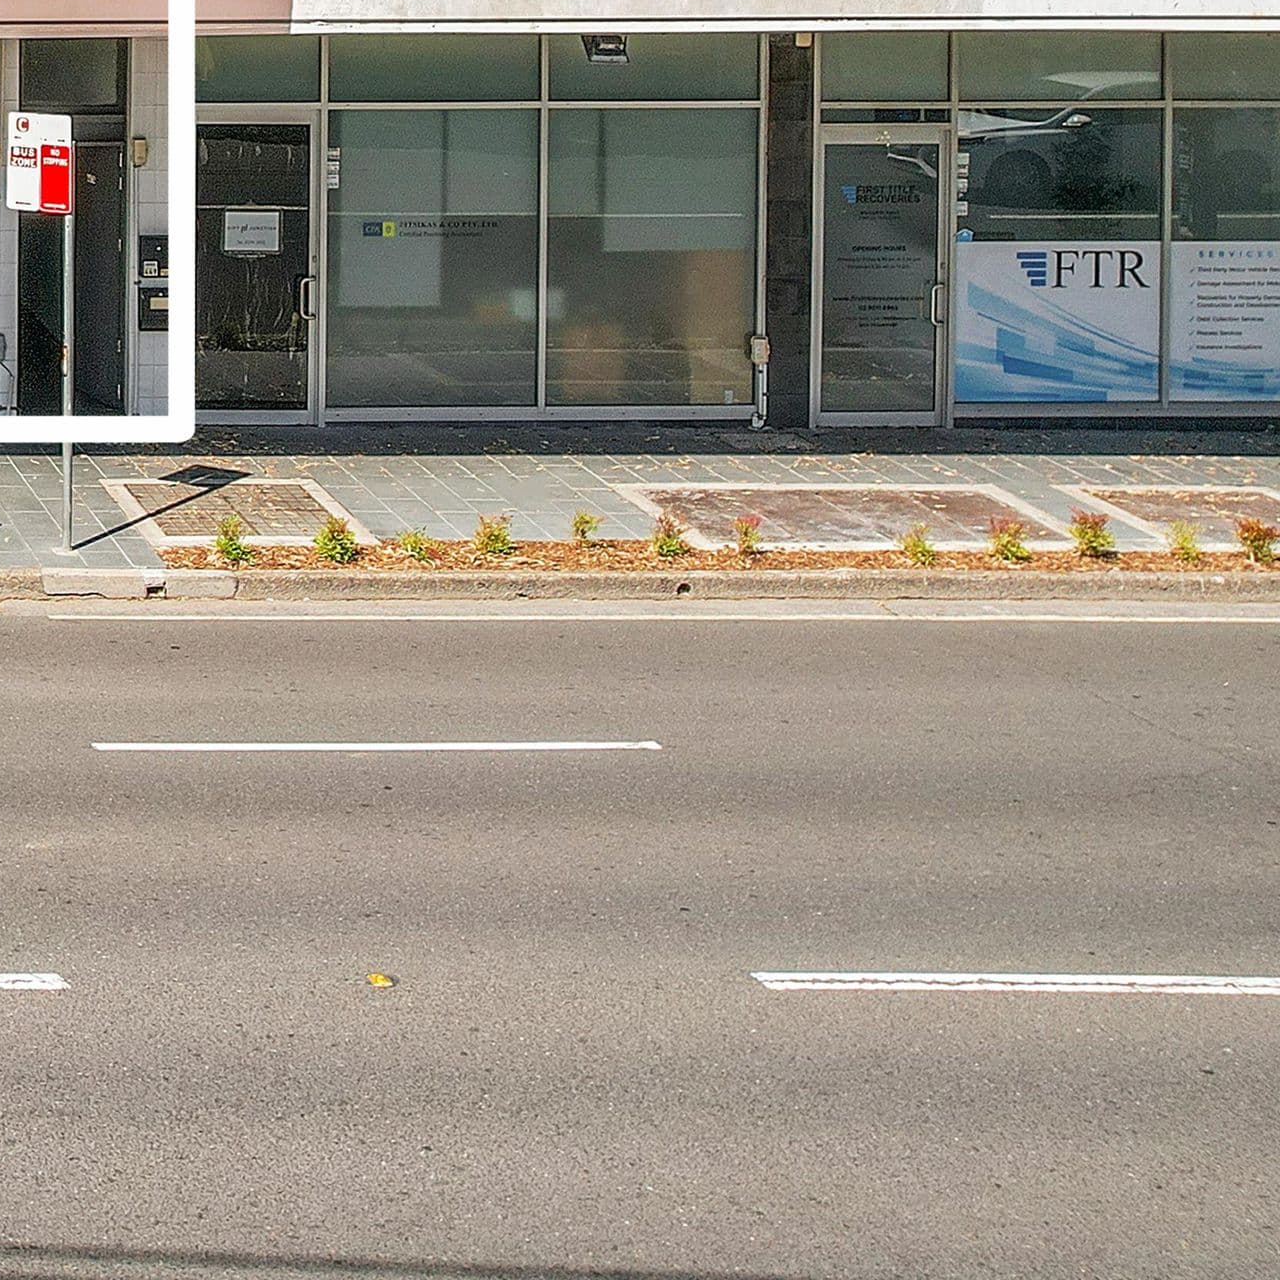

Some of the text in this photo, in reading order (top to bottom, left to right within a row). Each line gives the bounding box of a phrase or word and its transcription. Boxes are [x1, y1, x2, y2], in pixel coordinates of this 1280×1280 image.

[12, 146, 36, 157] BUS
[11, 157, 37, 168] ZONE
[1051, 249, 1151, 289] FTR
